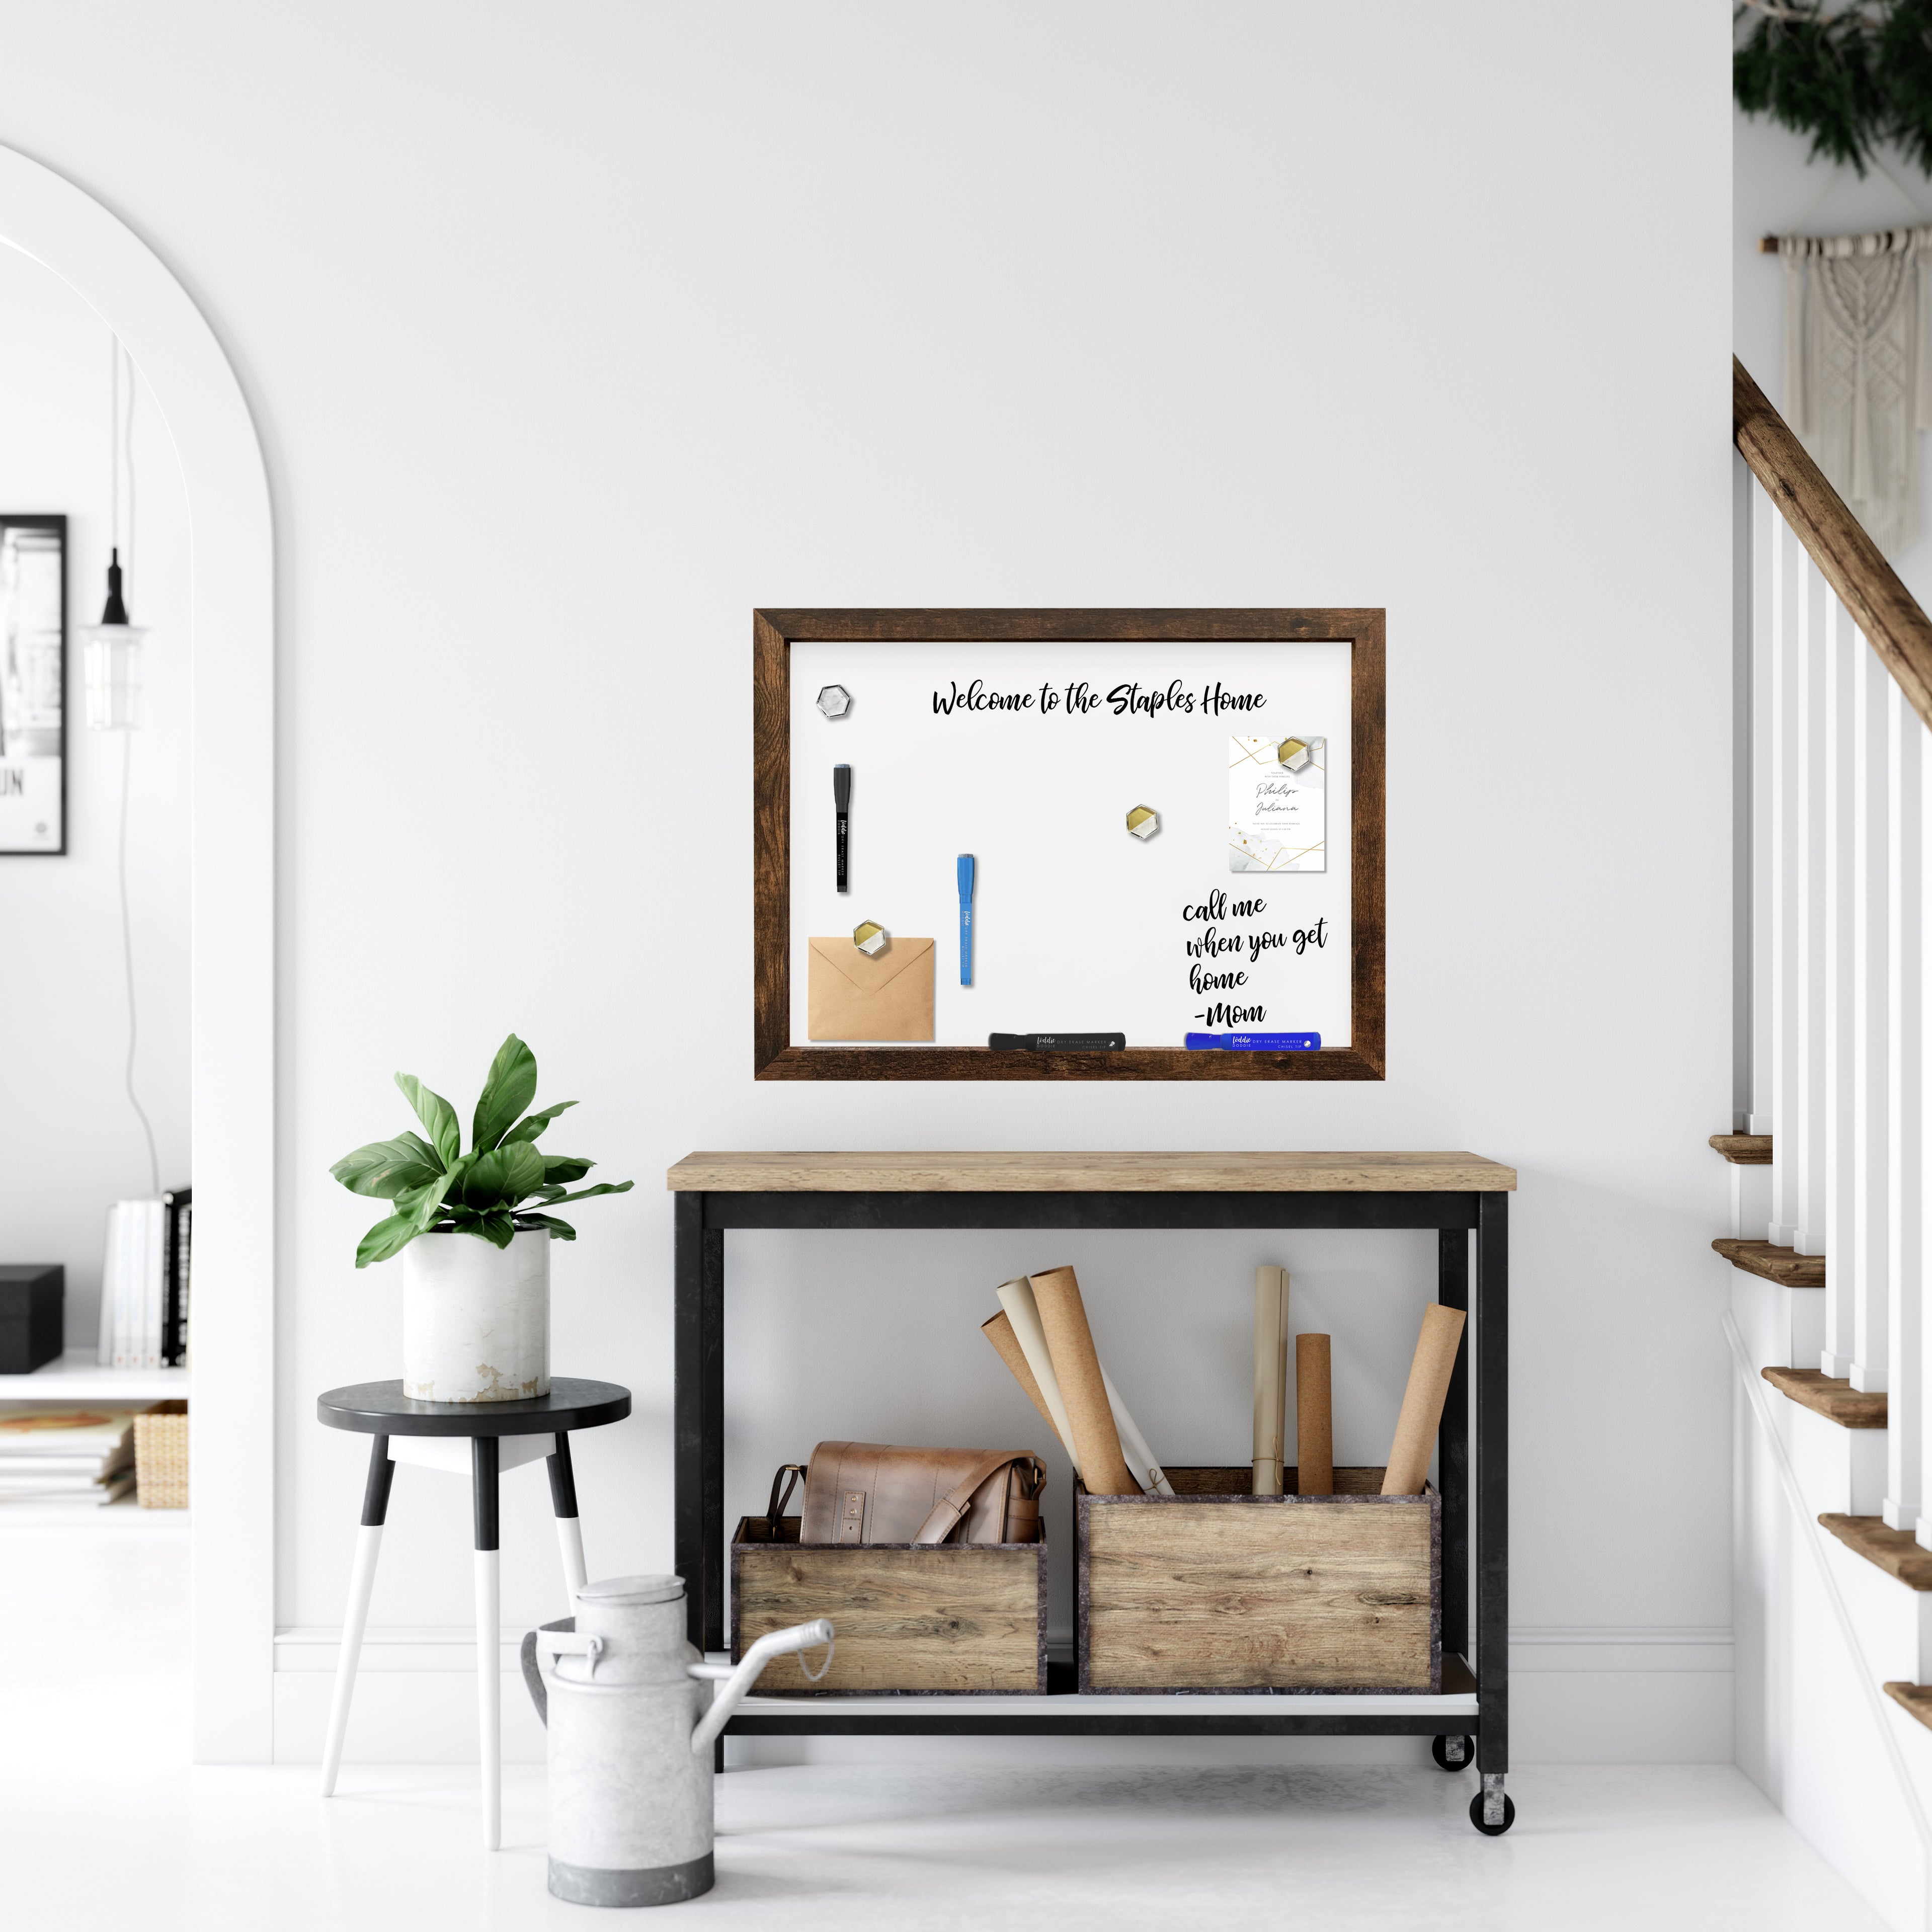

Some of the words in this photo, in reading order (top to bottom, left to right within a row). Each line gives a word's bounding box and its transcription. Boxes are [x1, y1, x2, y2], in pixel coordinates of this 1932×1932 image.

[933, 680, 1035, 714] Welcome
[1039, 683, 1061, 714] to
[1065, 682, 1102, 714] the
[1106, 680, 1196, 718] Staples
[1200, 682, 1267, 716] Home
[1256, 783, 1299, 798] Philip
[1255, 802, 1299, 816] Juliana
[1183, 889, 1227, 921] call
[1233, 899, 1267, 917] me
[1187, 927, 1244, 957] when
[1249, 932, 1287, 962] you
[1293, 917, 1328, 955] get
[1190, 963, 1248, 994] home
[1195, 1003, 1266, 1027] -Mom
